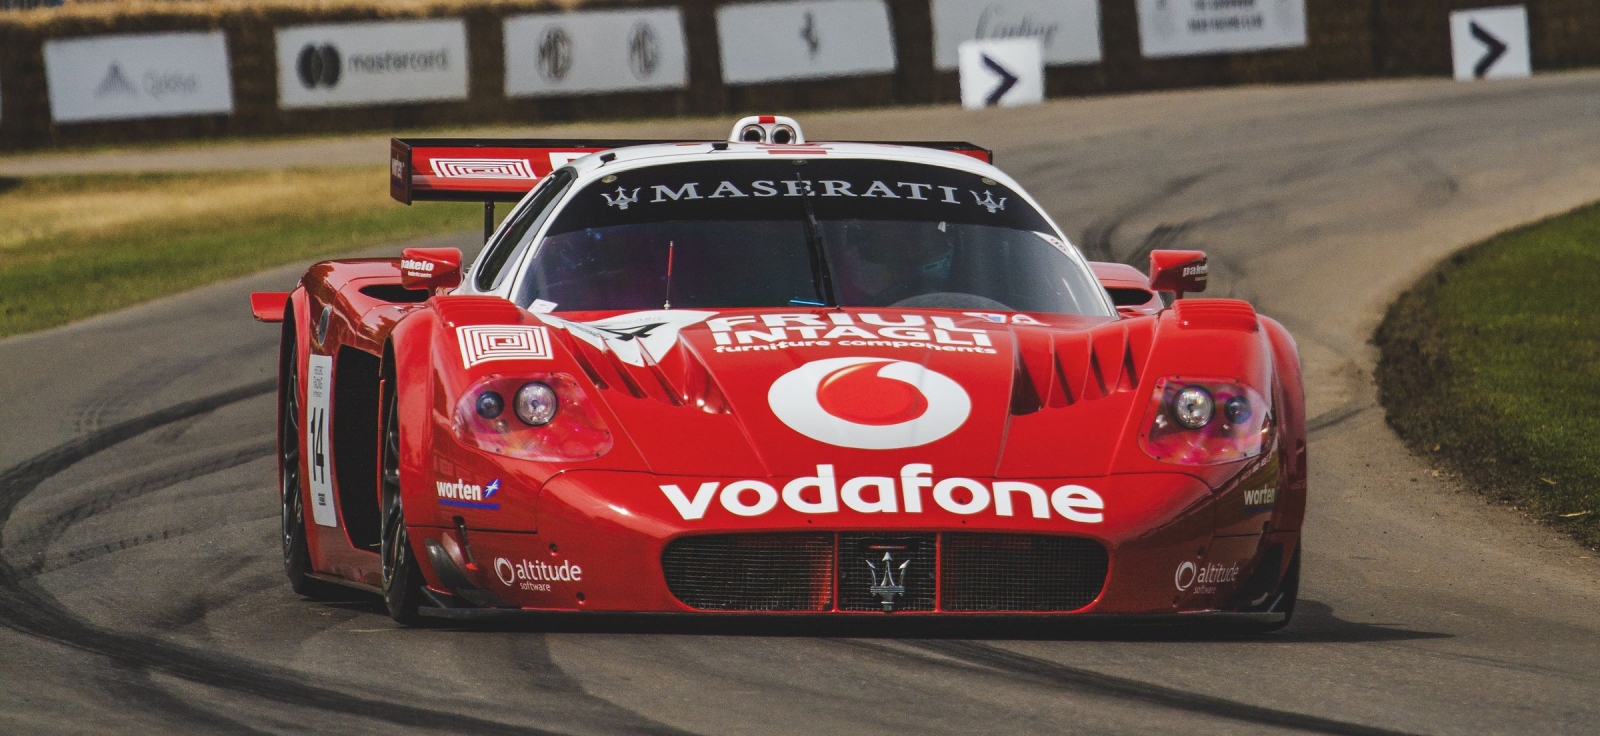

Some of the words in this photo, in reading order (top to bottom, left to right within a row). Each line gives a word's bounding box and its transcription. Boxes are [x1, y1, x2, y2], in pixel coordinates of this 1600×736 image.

[539, 30, 571, 78] MG
[650, 180, 961, 204] MASERATI
[706, 313, 987, 334] FRIUL
[713, 325, 992, 347] INTAGLI
[713, 339, 831, 353] furniture
[837, 340, 997, 354] components
[310, 406, 325, 485] 14
[436, 478, 482, 501] worten
[659, 463, 1105, 523] vodafone
[515, 558, 582, 581] altitude
[1197, 562, 1239, 583] altitude
[519, 581, 551, 592] software
